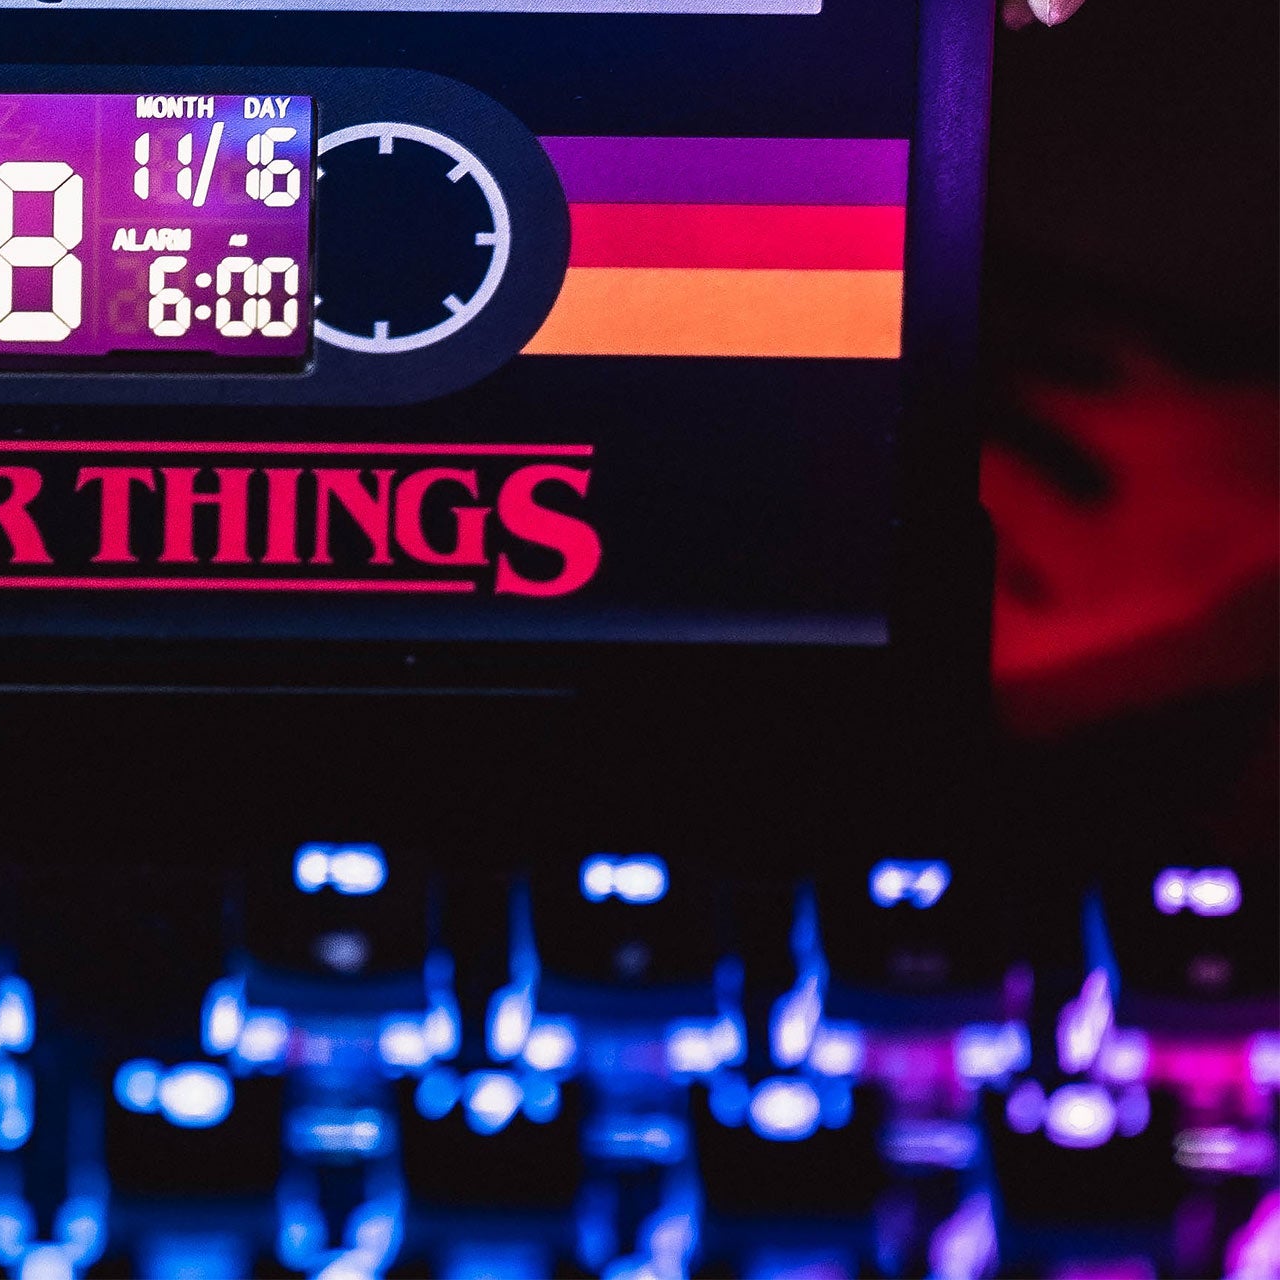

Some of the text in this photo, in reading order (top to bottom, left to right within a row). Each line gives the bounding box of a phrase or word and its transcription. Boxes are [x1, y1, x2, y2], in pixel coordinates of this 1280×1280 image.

[135, 95, 291, 119] MONTH DAY
[111, 227, 192, 252] ALARM
[148, 255, 299, 337] 6:00
[76, 464, 603, 597] THINGS
